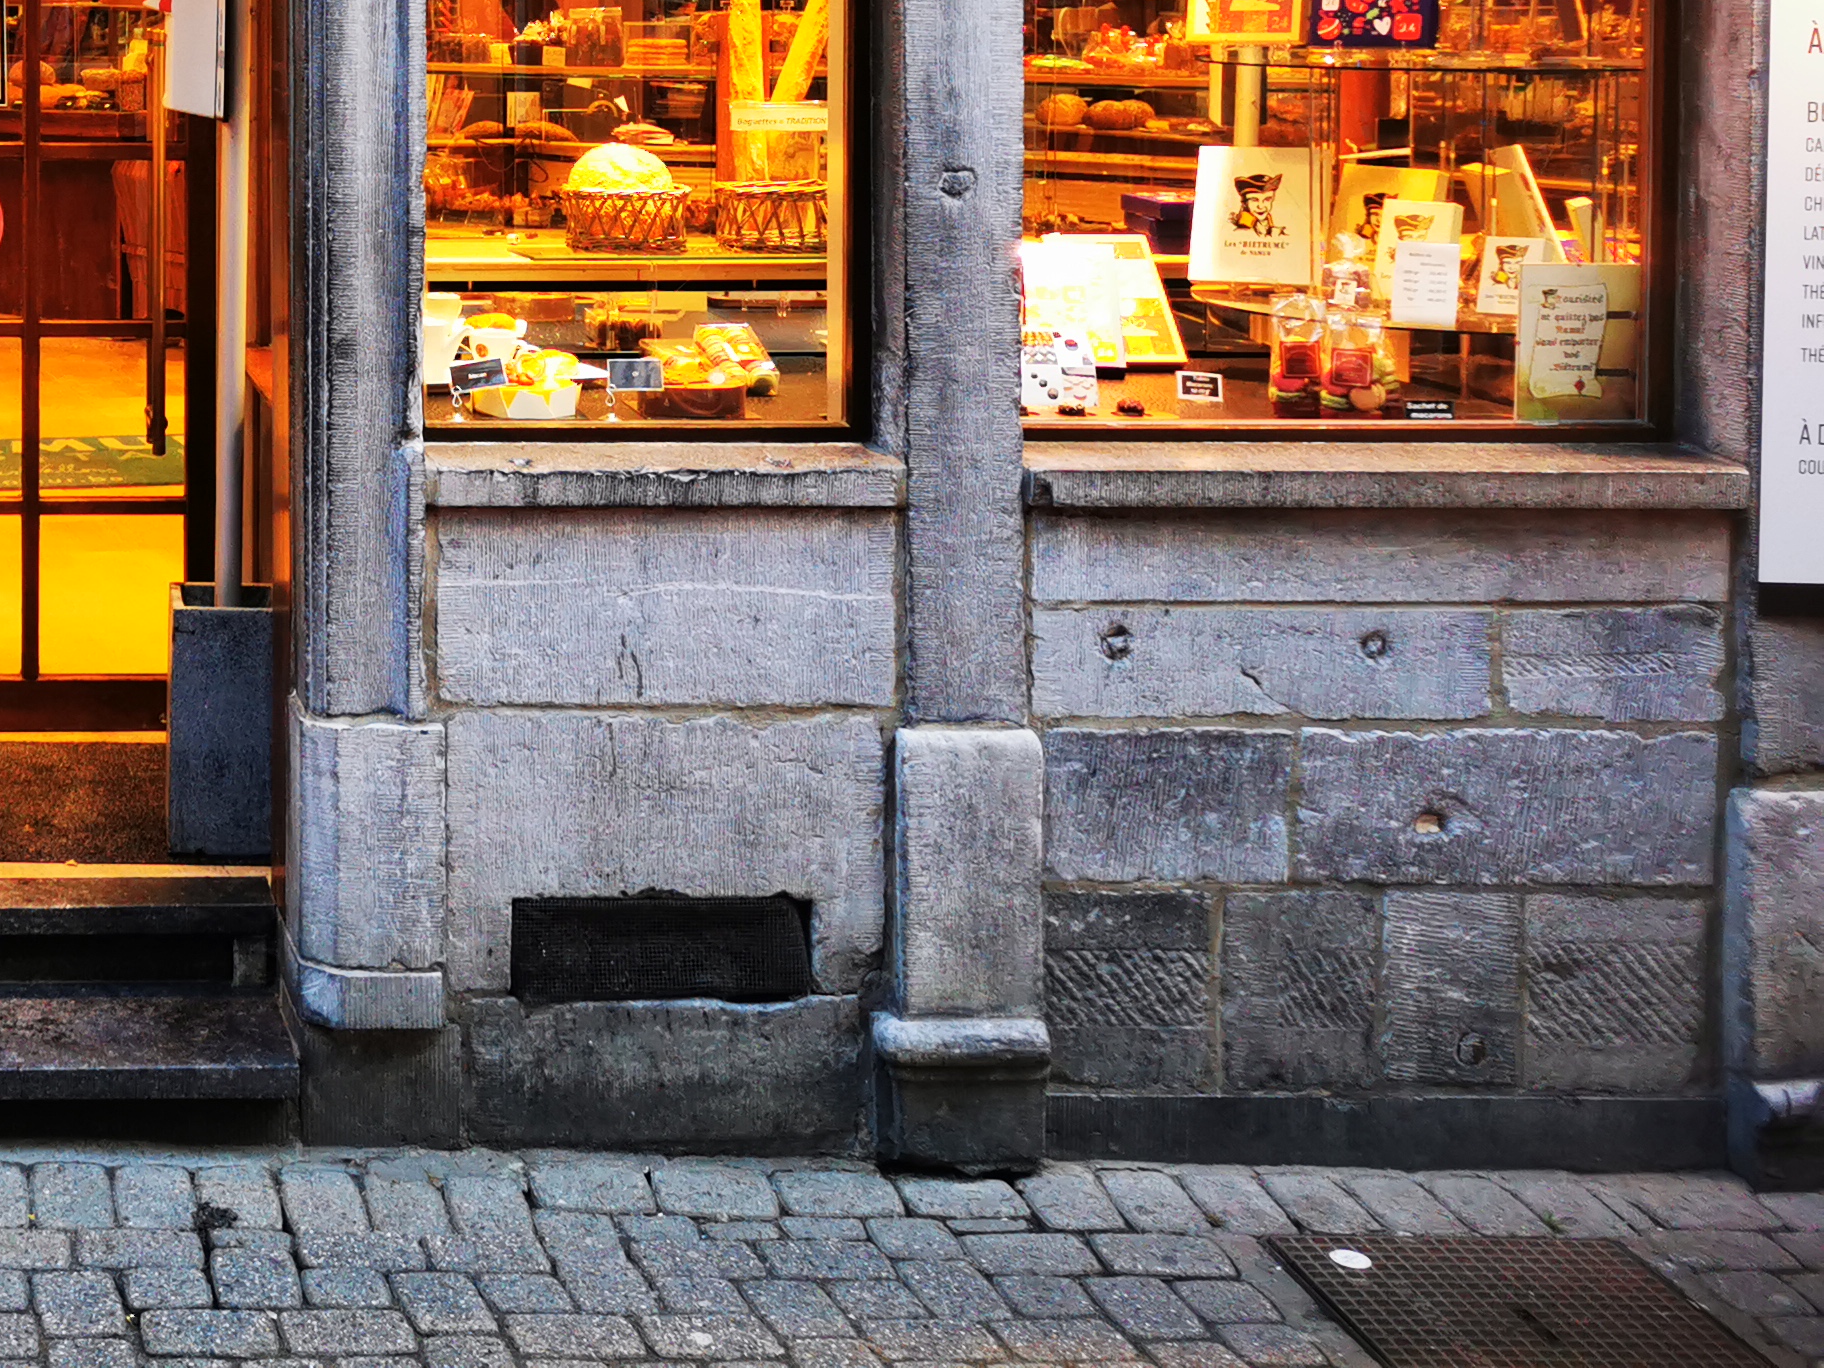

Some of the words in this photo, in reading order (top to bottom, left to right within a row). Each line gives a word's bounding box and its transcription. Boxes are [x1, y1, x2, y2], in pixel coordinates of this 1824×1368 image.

[1807, 19, 1823, 53] À
[737, 118, 777, 126] Baguettes
[1805, 163, 1824, 182] DÉ
[1804, 196, 1824, 212] CH
[1799, 418, 1811, 445] À
